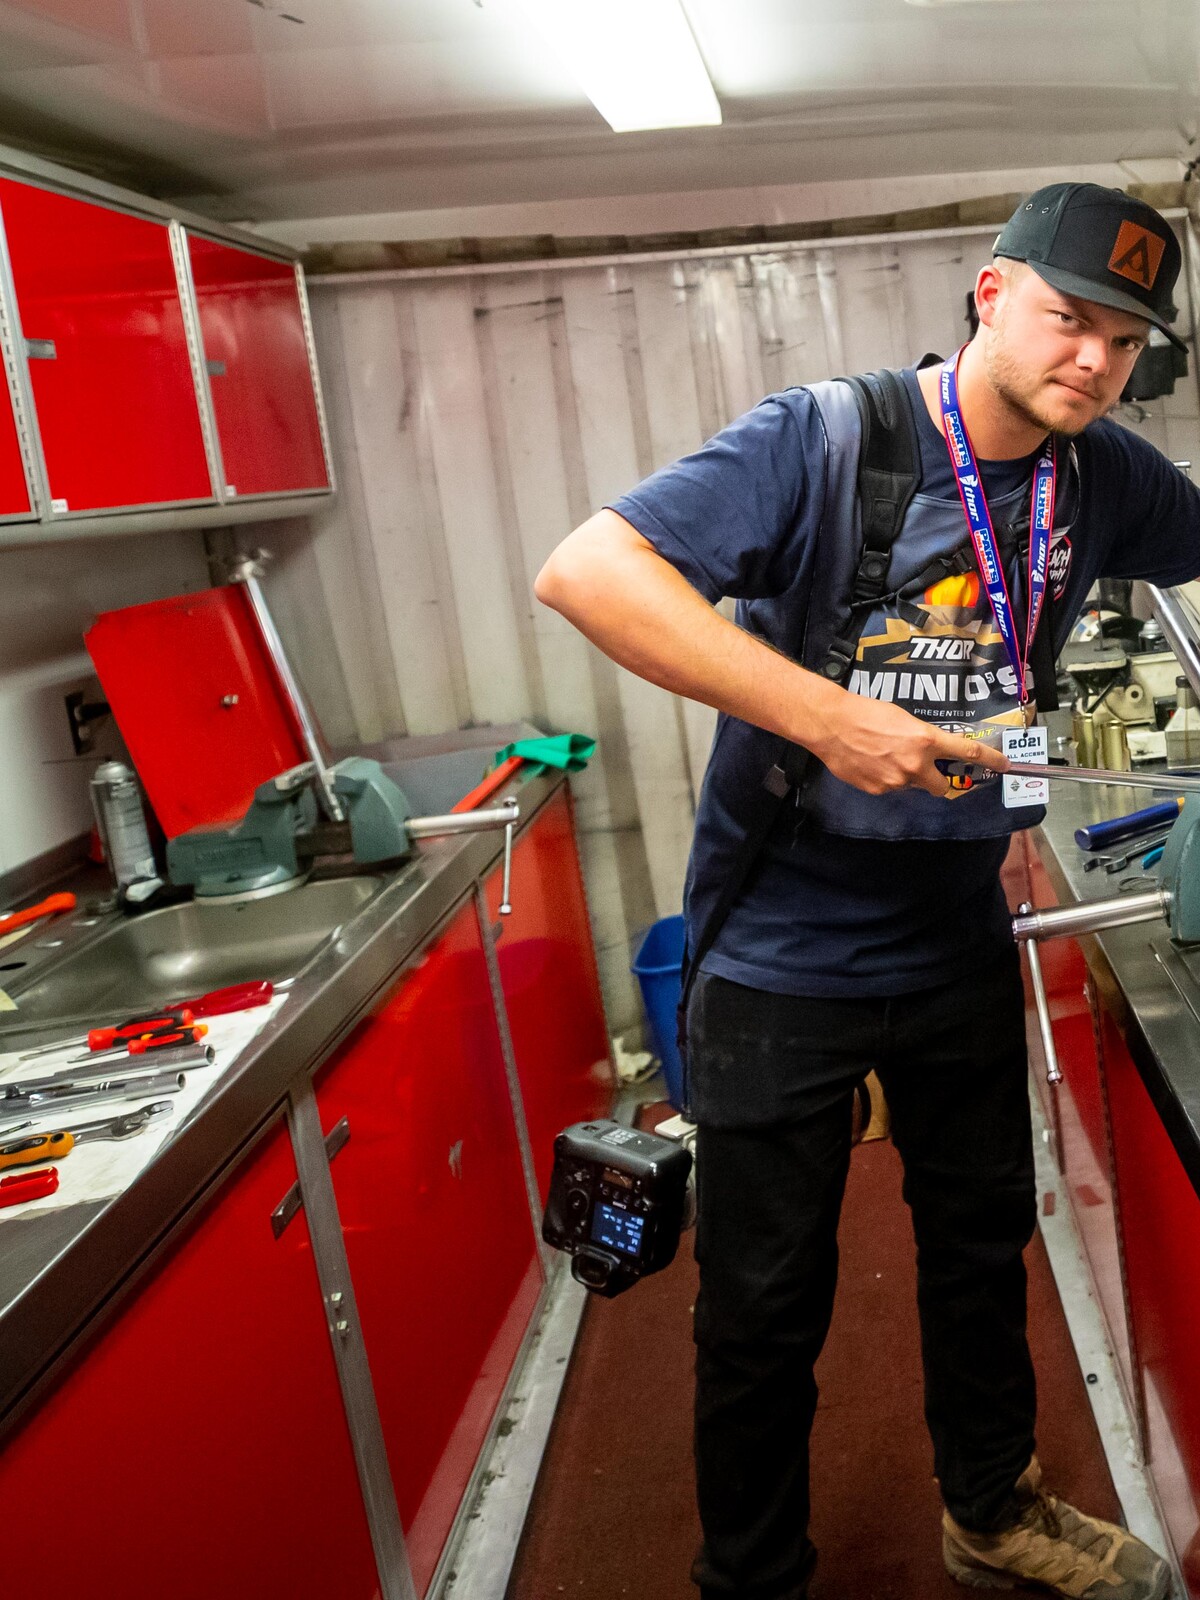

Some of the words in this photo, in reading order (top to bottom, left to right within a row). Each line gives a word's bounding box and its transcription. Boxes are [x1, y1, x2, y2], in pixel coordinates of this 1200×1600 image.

[950, 411, 970, 466] PARTS
[964, 487, 979, 522] thor
[1037, 478, 1047, 528] PARTS
[979, 530, 998, 583] PARTS
[1037, 537, 1047, 570] thor
[995, 603, 1008, 637] thor
[910, 637, 975, 660] THOR
[914, 708, 964, 717] PRESENTED
[966, 709, 976, 717] BY
[1008, 737, 1041, 750] 2021
